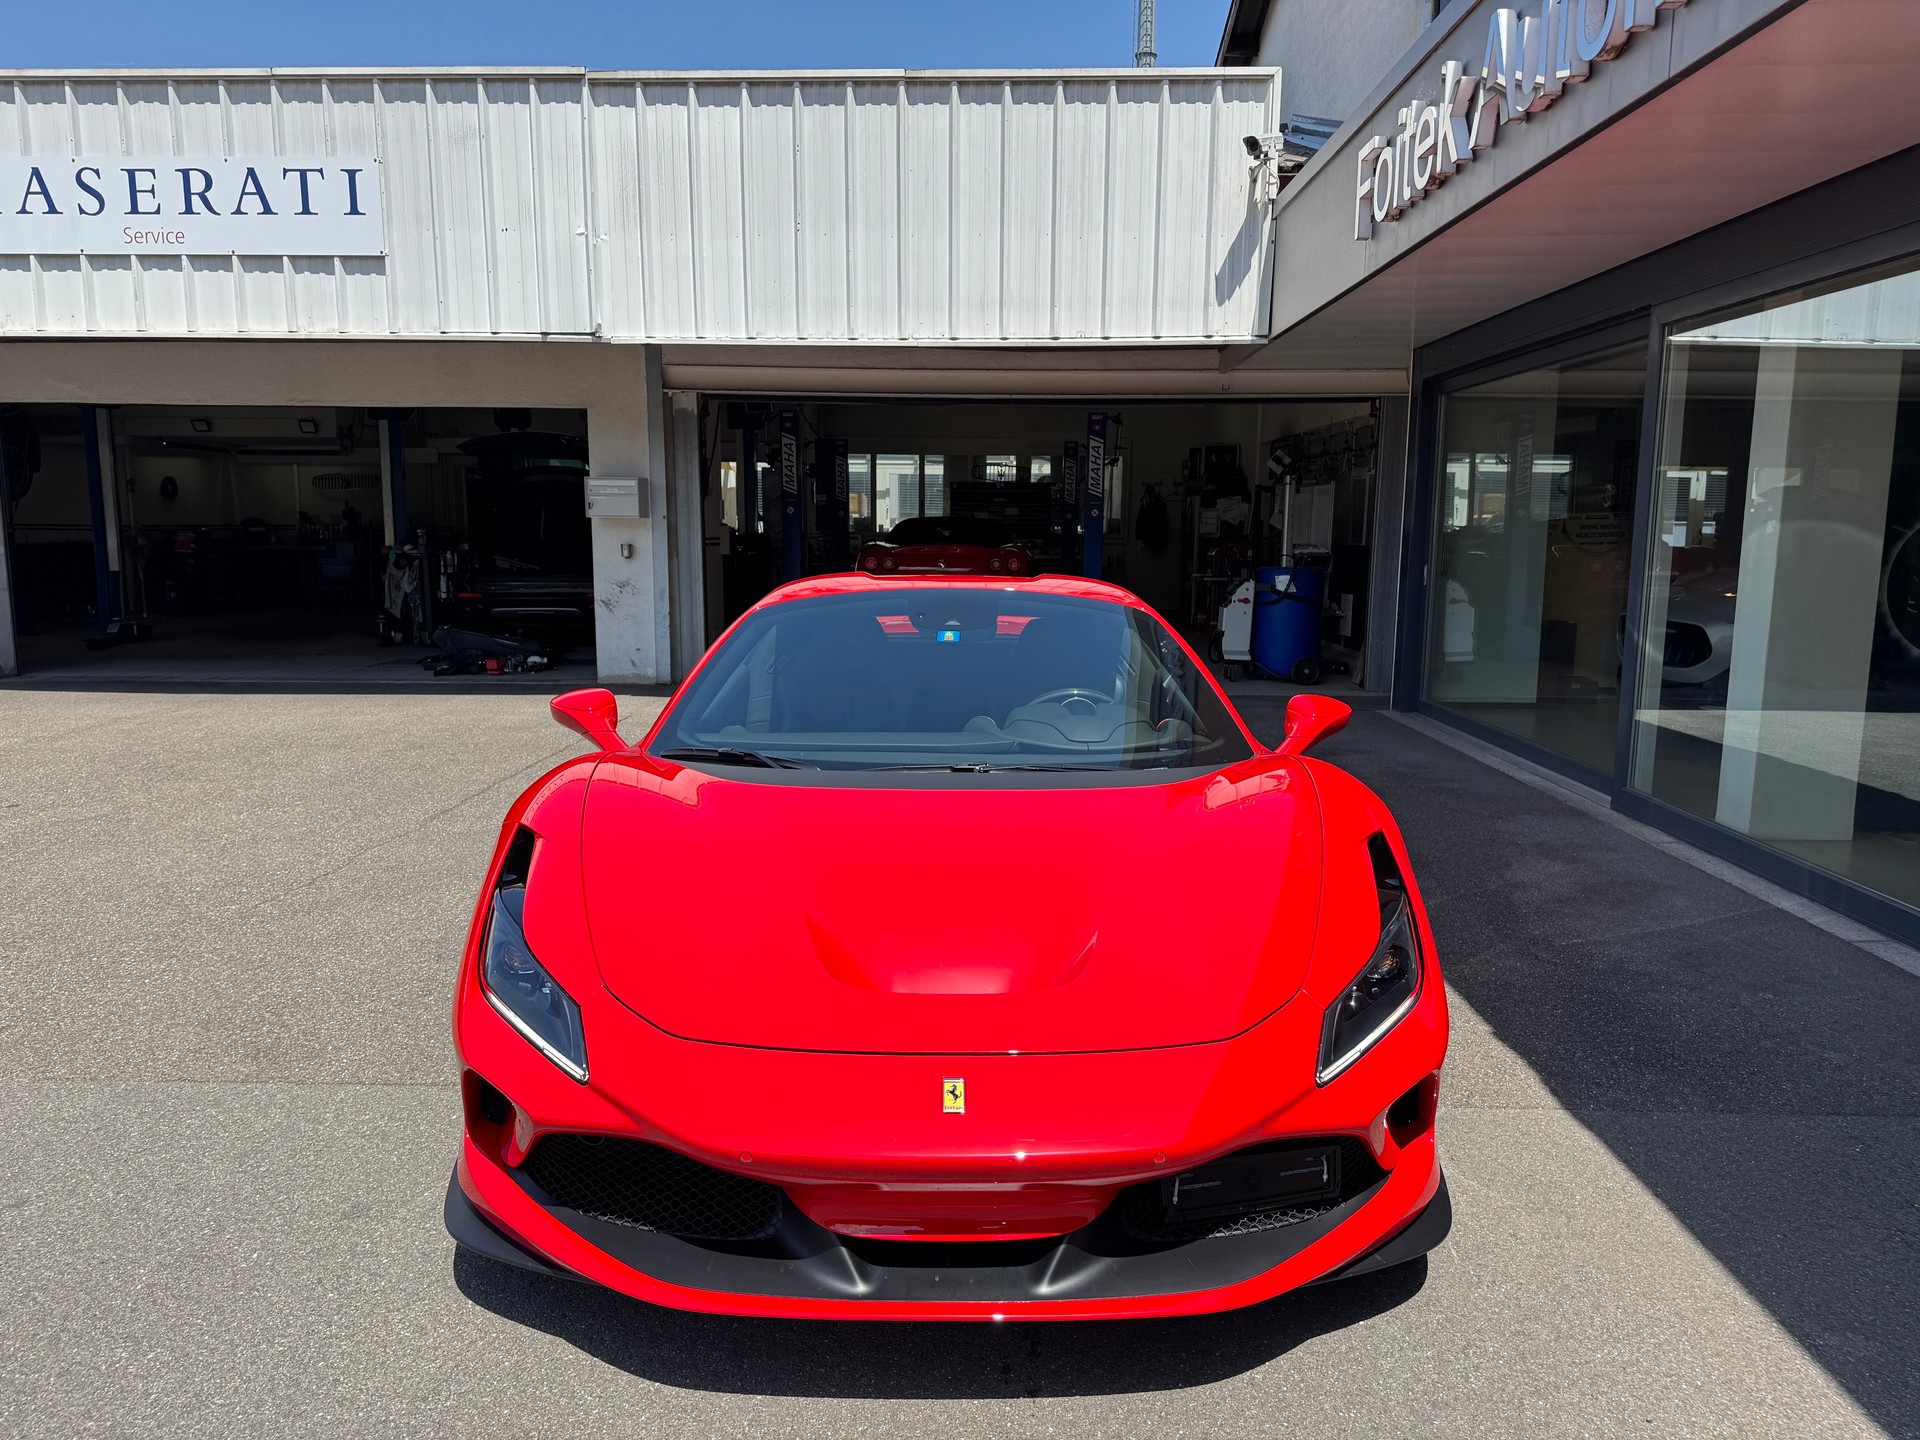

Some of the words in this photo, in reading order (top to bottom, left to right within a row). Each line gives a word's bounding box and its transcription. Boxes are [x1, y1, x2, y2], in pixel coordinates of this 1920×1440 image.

[1355, 61, 1474, 240] Foitek
[0, 166, 366, 217] ASERATI
[123, 227, 186, 245] Service
[783, 442, 795, 488] MAHA
[1066, 464, 1075, 500] MAHA
[1090, 444, 1102, 489] MAHA
